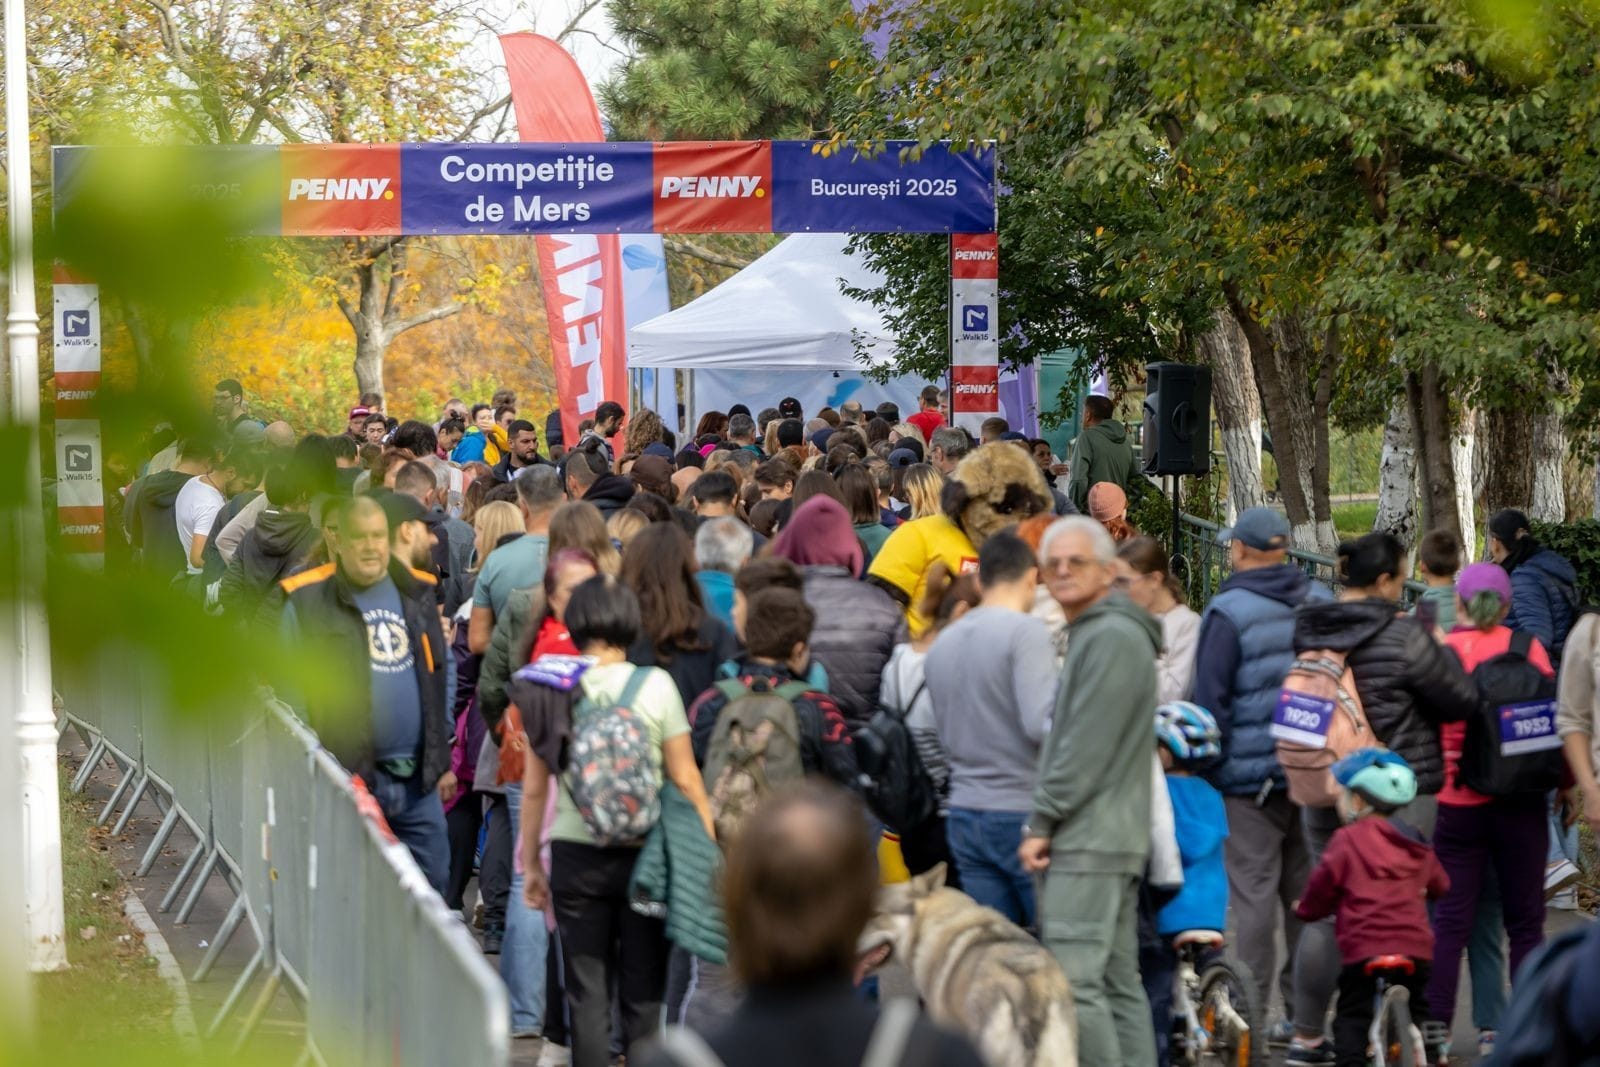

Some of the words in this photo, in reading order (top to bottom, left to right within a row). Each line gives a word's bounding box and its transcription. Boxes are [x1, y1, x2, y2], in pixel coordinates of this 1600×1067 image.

[660, 176, 765, 198] PENNY.
[906, 180, 957, 197] 2025
[465, 196, 504, 222] de
[514, 196, 590, 222] Mers
[963, 333, 989, 341] Walk15
[1284, 706, 1321, 730] 1920
